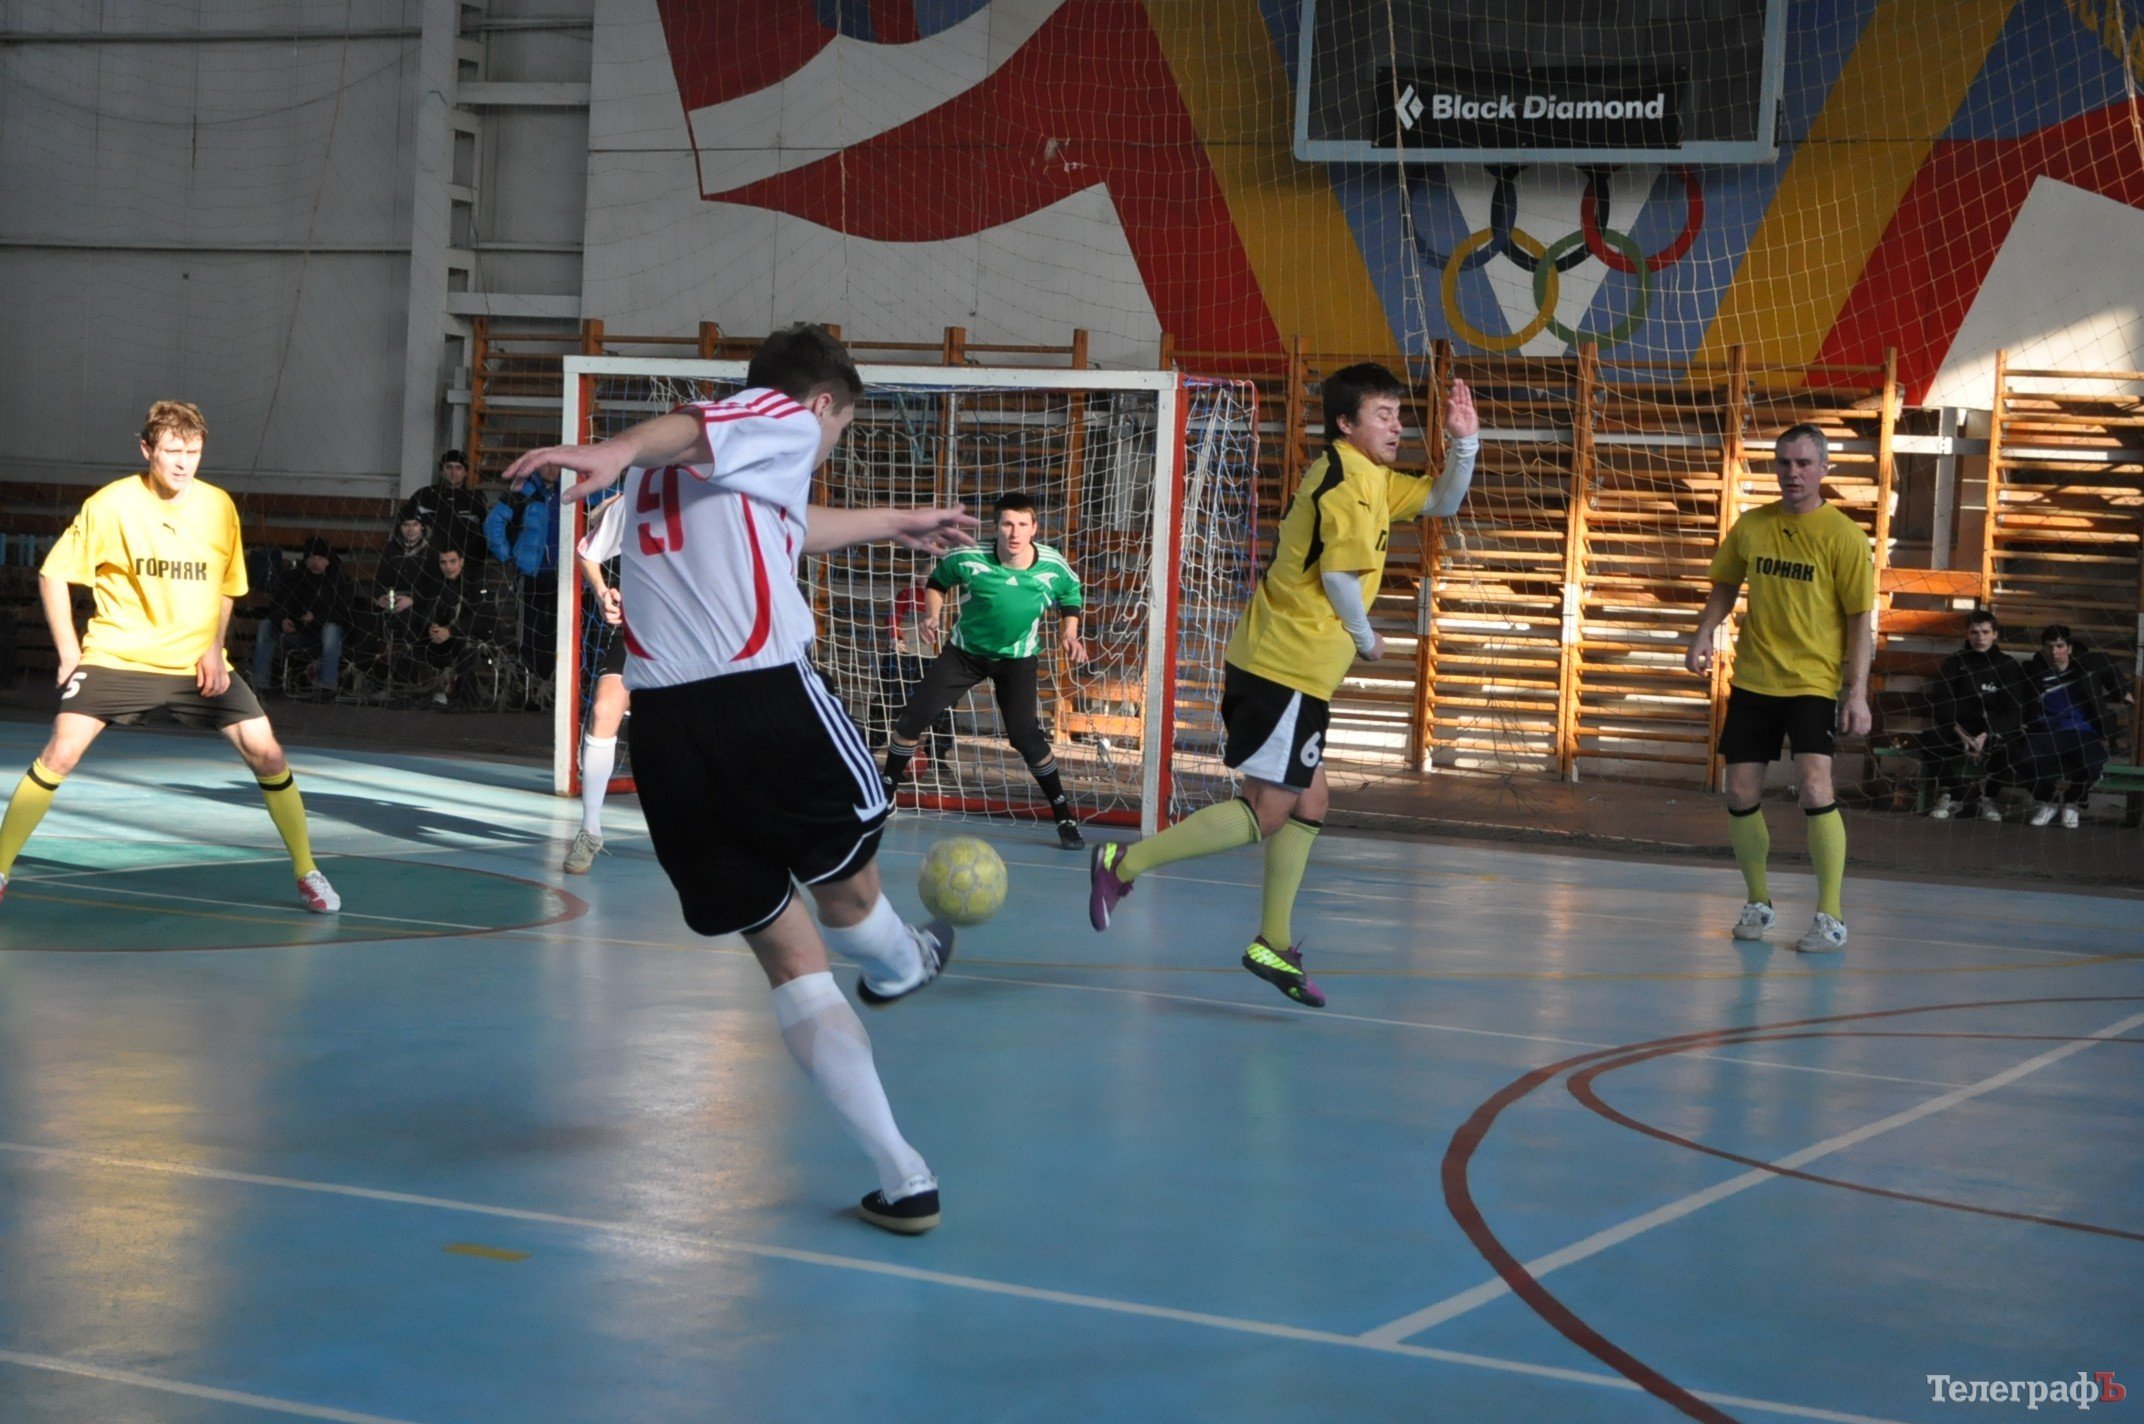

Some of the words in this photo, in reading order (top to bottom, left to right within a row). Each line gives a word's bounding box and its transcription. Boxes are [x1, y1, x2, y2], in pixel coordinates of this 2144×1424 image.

[1432, 95, 1516, 120] Black
[1523, 93, 1664, 120] Diamond
[135, 557, 207, 581] ГОРНЯК
[1755, 555, 1815, 582] ГОРНЯК
[1300, 730, 1322, 768] 6
